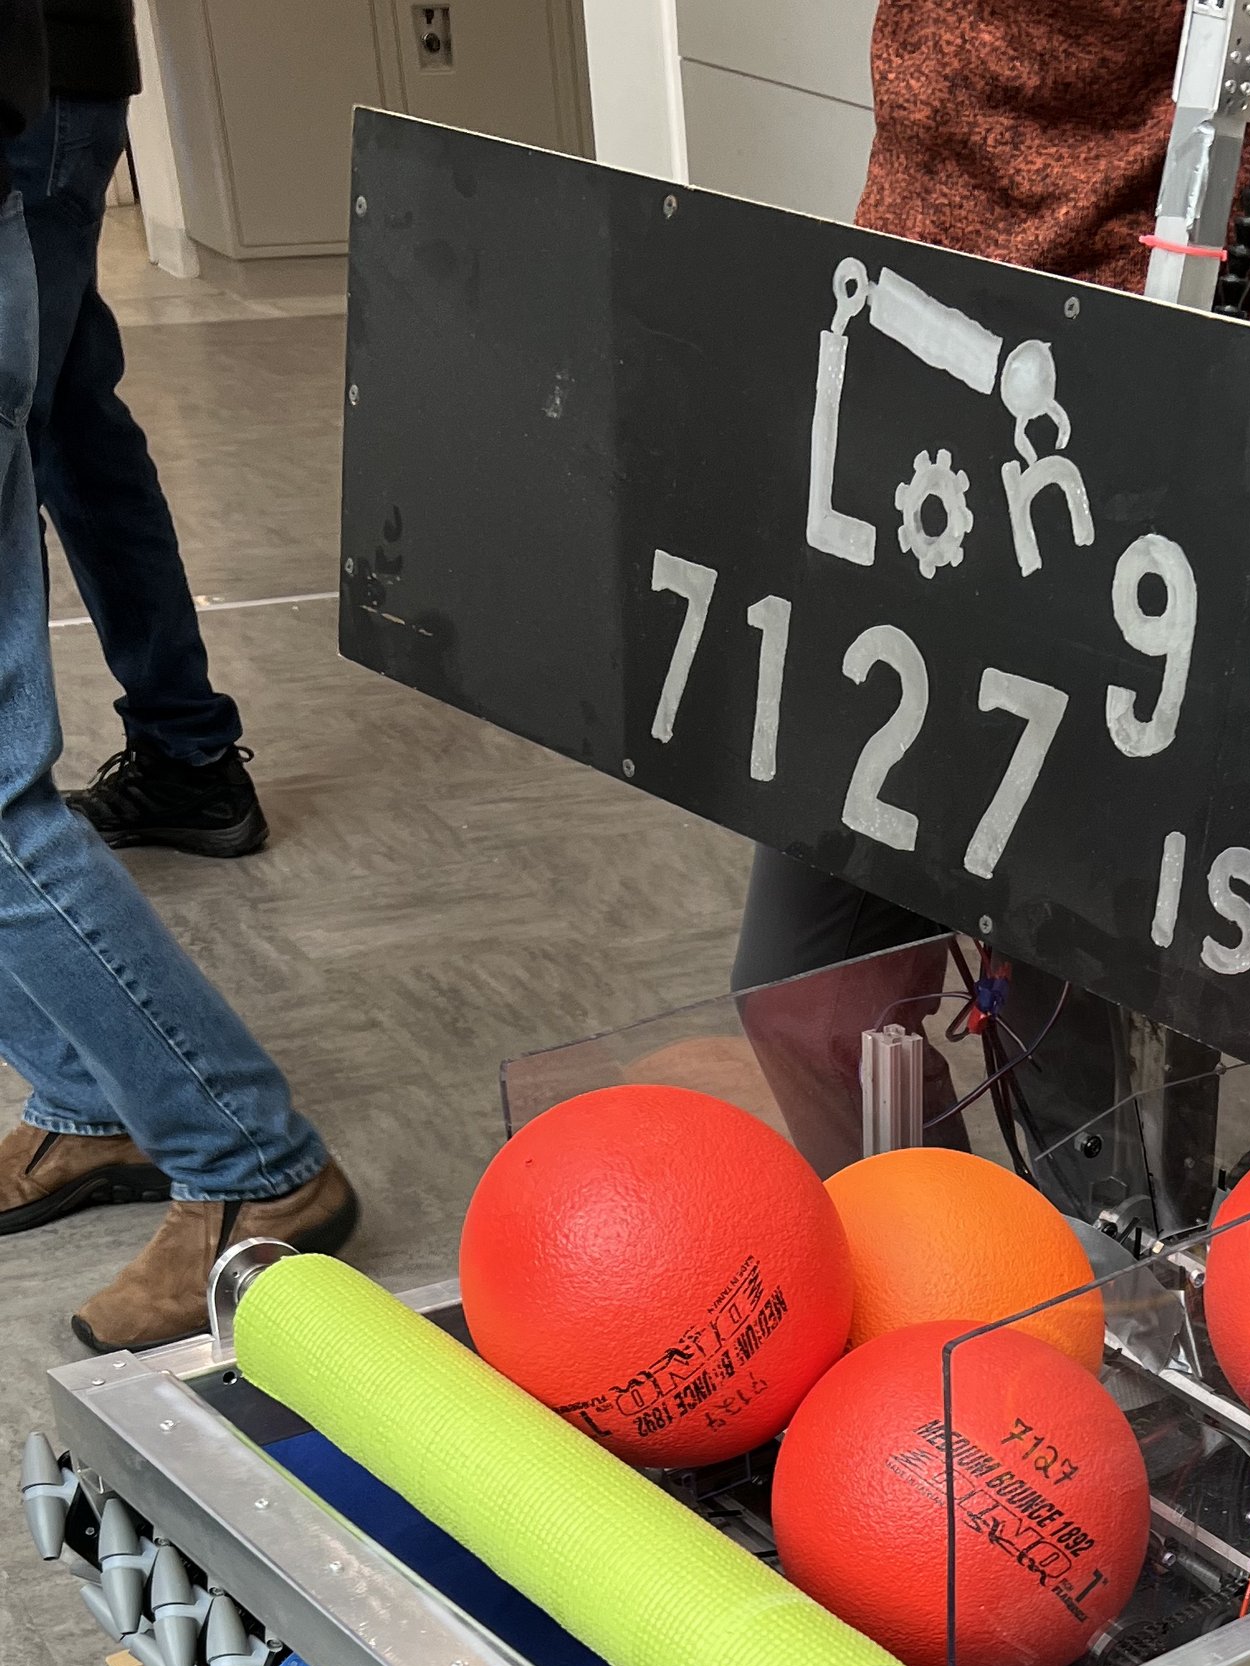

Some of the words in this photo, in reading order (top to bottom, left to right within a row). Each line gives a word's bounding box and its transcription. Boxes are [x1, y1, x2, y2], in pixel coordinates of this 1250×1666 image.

[806, 257, 1198, 758] Long
[651, 549, 1069, 880] 7127
[912, 1418, 1004, 1479] MEDIUM
[985, 1470, 1065, 1529] BOUNCE
[1049, 1519, 1097, 1558] 1892
[1001, 1417, 1079, 1486] 7127
